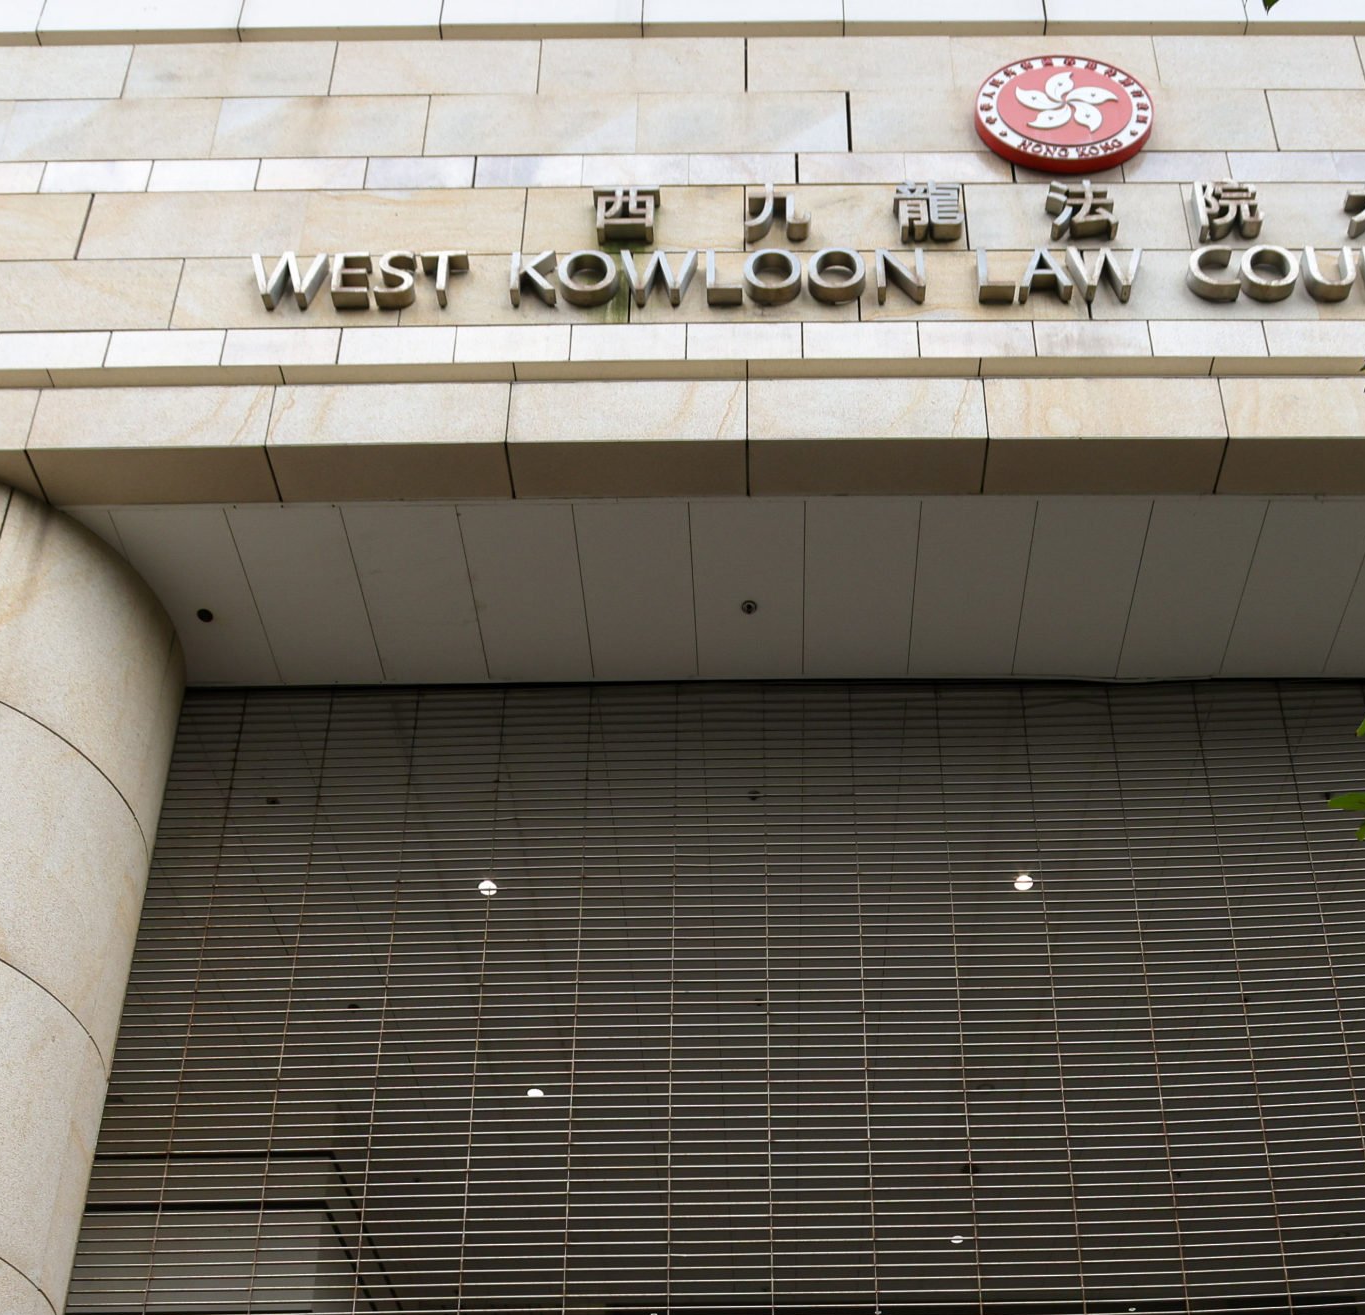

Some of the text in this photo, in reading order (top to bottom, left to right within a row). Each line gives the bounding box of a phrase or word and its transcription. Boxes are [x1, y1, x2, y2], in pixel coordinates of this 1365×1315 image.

[251, 248, 471, 310] WEST
[509, 247, 928, 307] KOWLOON
[975, 247, 1144, 303] LAW
